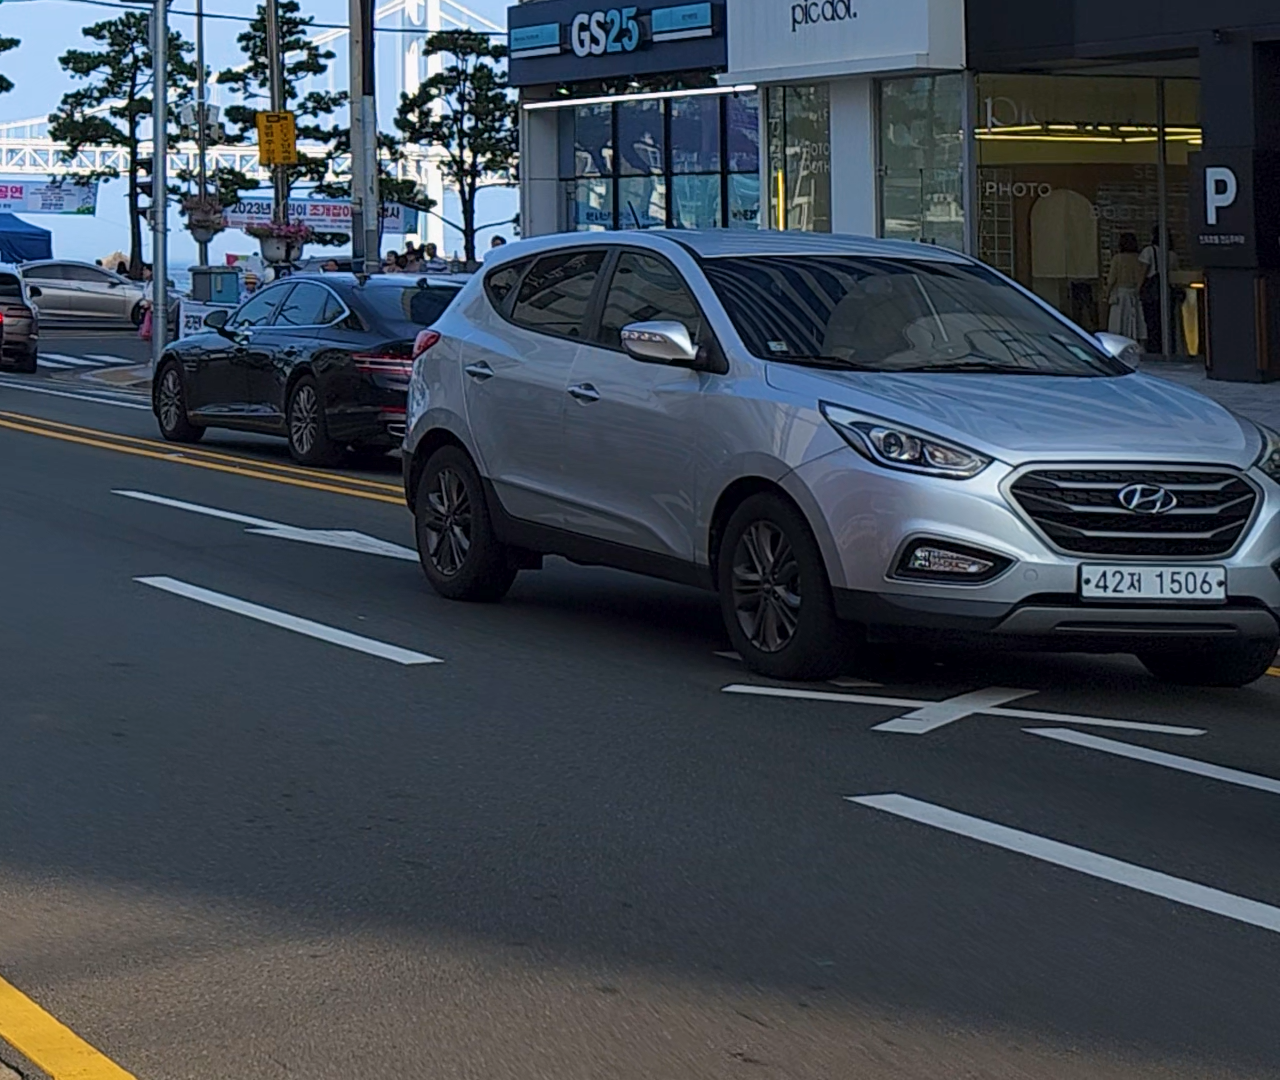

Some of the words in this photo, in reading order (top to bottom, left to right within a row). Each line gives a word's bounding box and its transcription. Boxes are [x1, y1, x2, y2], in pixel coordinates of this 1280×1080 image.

[571, 7, 639, 58] GS25
[985, 182, 1053, 198] PHOTO
[1206, 166, 1237, 225] P
[231, 202, 271, 215] 2023년
[1095, 571, 1142, 593] 42저
[1155, 571, 1213, 594] 1506
